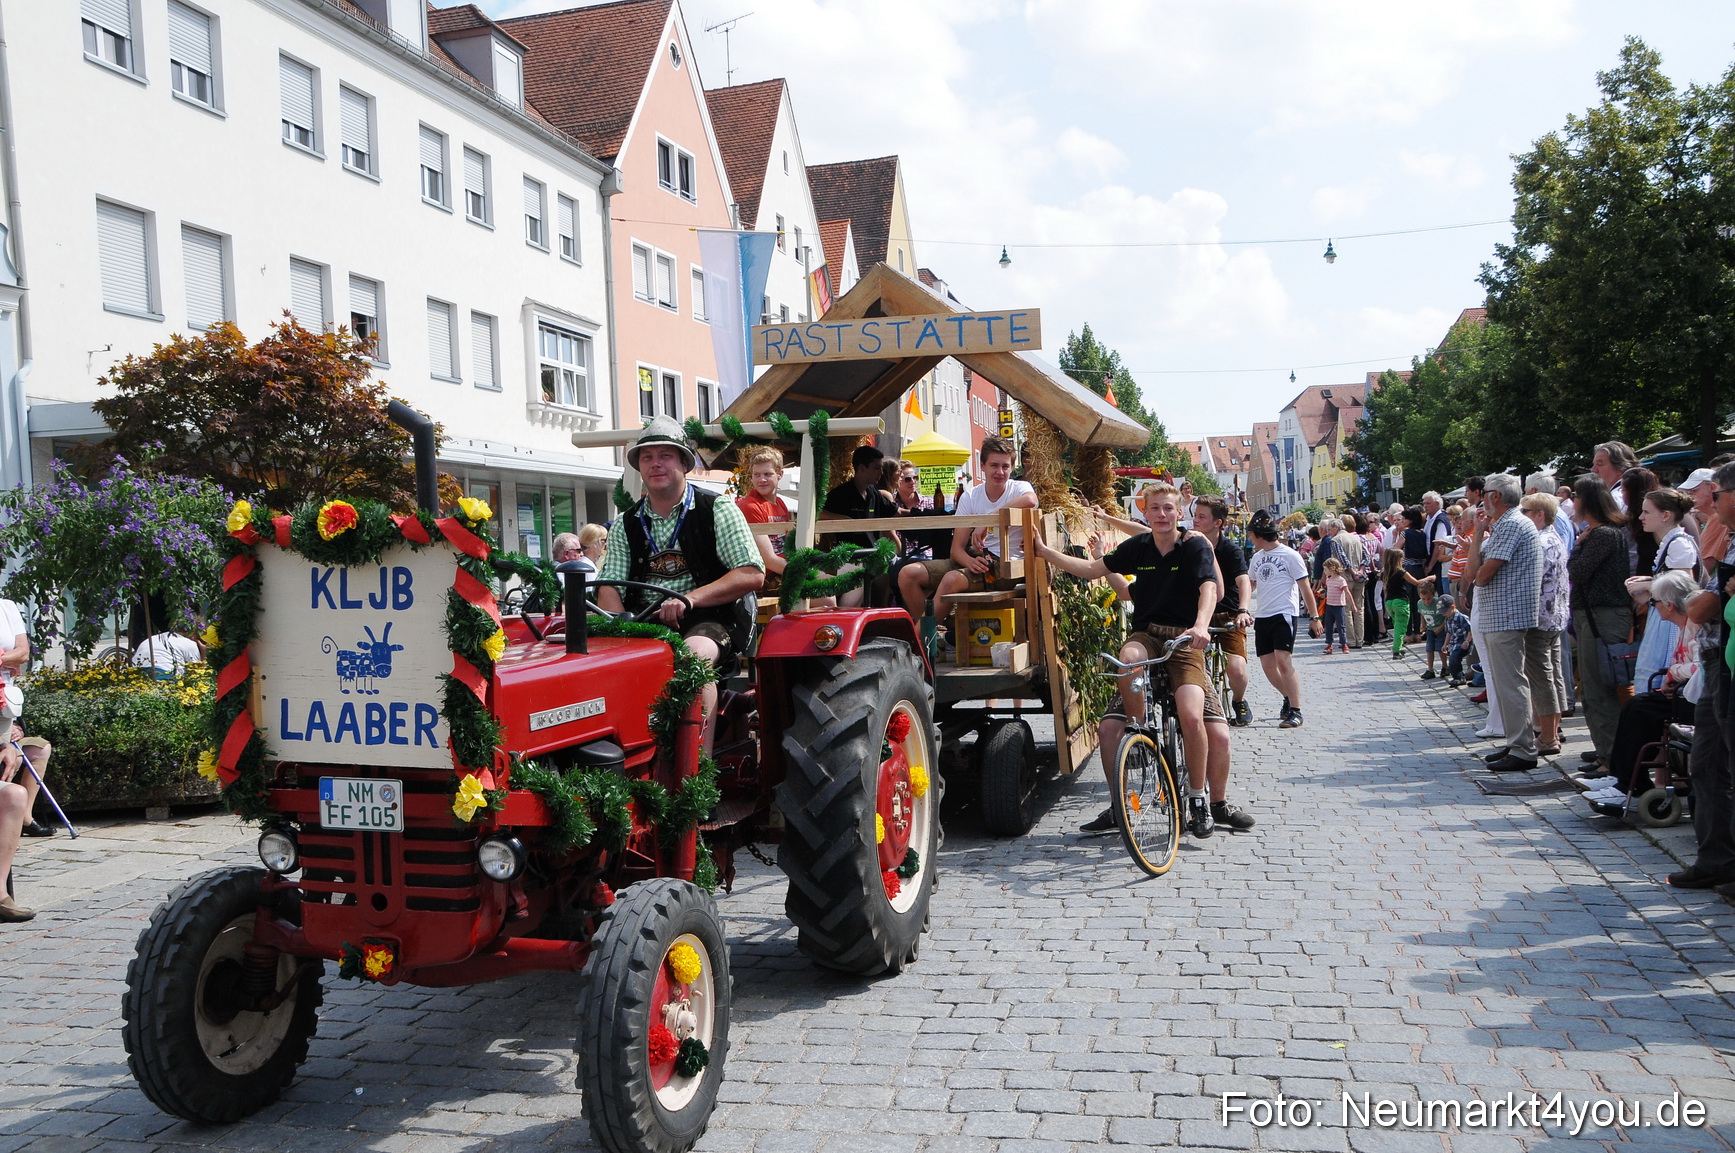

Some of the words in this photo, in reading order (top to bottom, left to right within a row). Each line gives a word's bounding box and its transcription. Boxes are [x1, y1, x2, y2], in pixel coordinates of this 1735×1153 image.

[1253, 555, 1287, 572] GERMANY
[311, 566, 414, 611] KLJB
[281, 698, 440, 749] LAABER
[324, 792, 330, 800] D
[348, 782, 374, 804] NM
[327, 804, 353, 825] FF
[358, 805, 396, 828] 105
